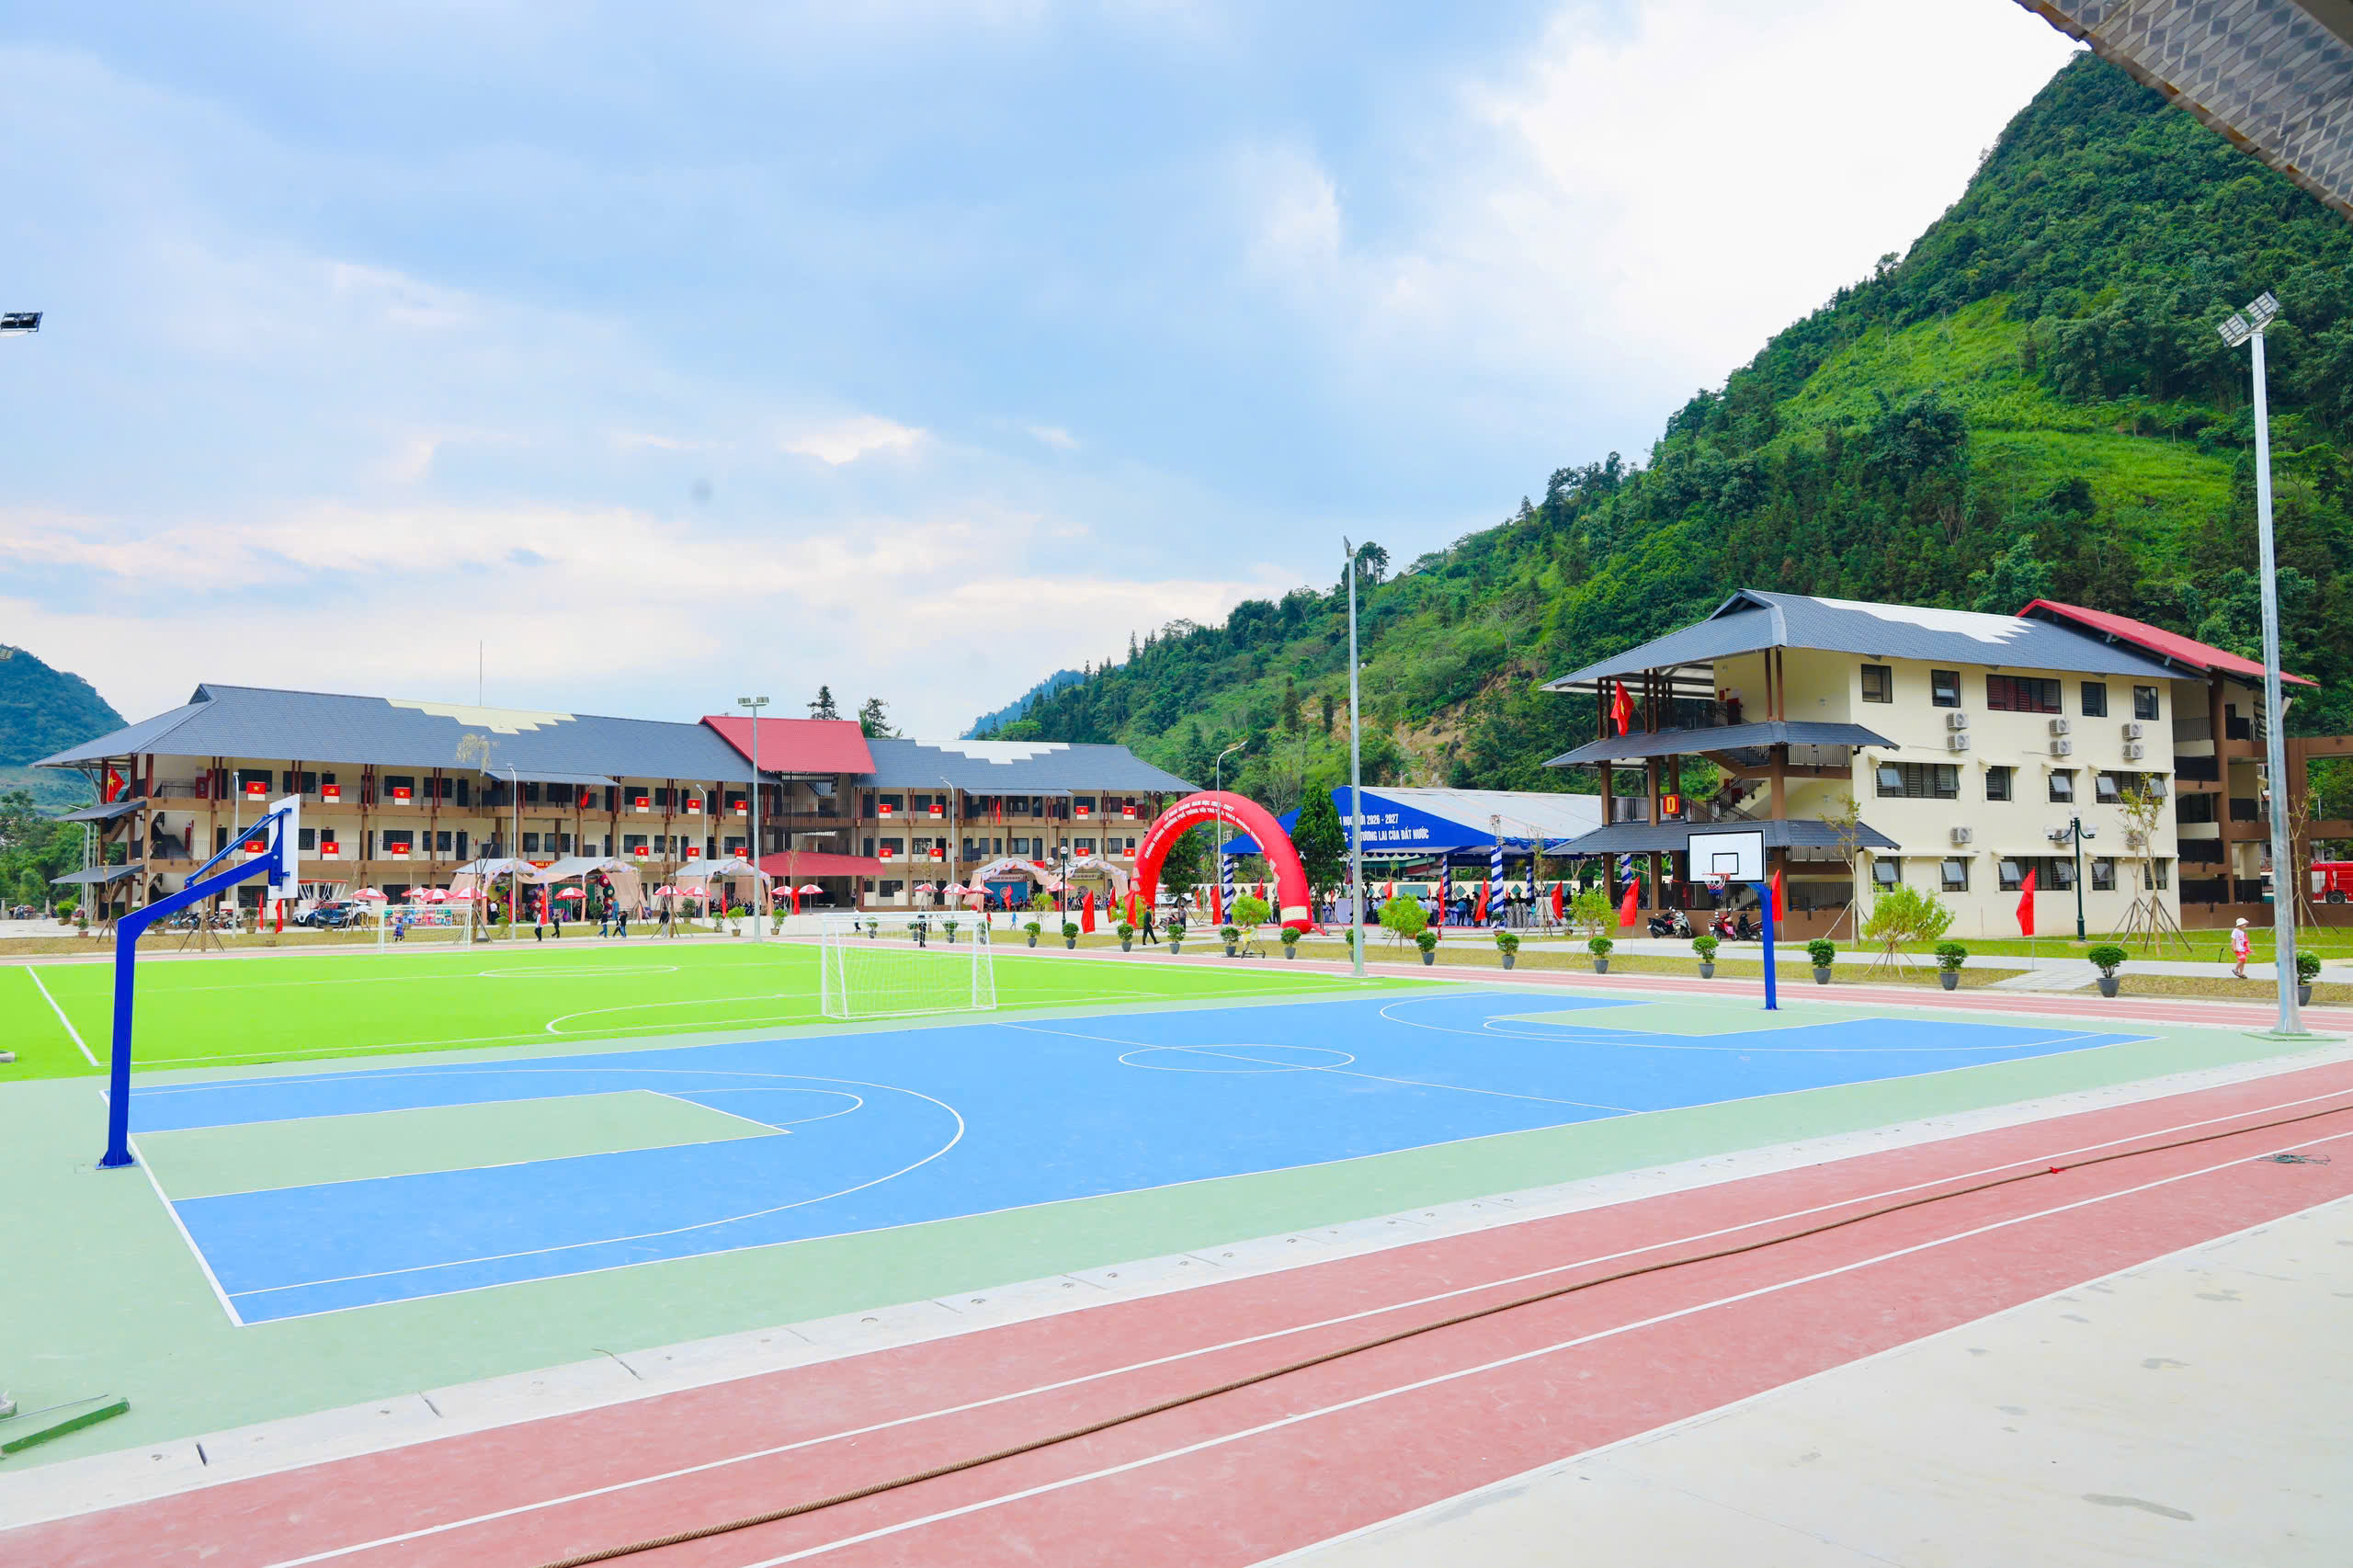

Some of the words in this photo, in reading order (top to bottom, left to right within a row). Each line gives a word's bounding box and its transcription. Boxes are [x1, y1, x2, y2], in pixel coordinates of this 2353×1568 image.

[1666, 796, 1675, 812] D
[1367, 814, 1380, 825] 2026
[1385, 813, 1398, 824] 2027
[1378, 830, 1387, 841] LAI
[1388, 826, 1400, 840] CỦA
[1401, 826, 1412, 840] ĐẤT
[1413, 826, 1429, 840] NƯỚC
